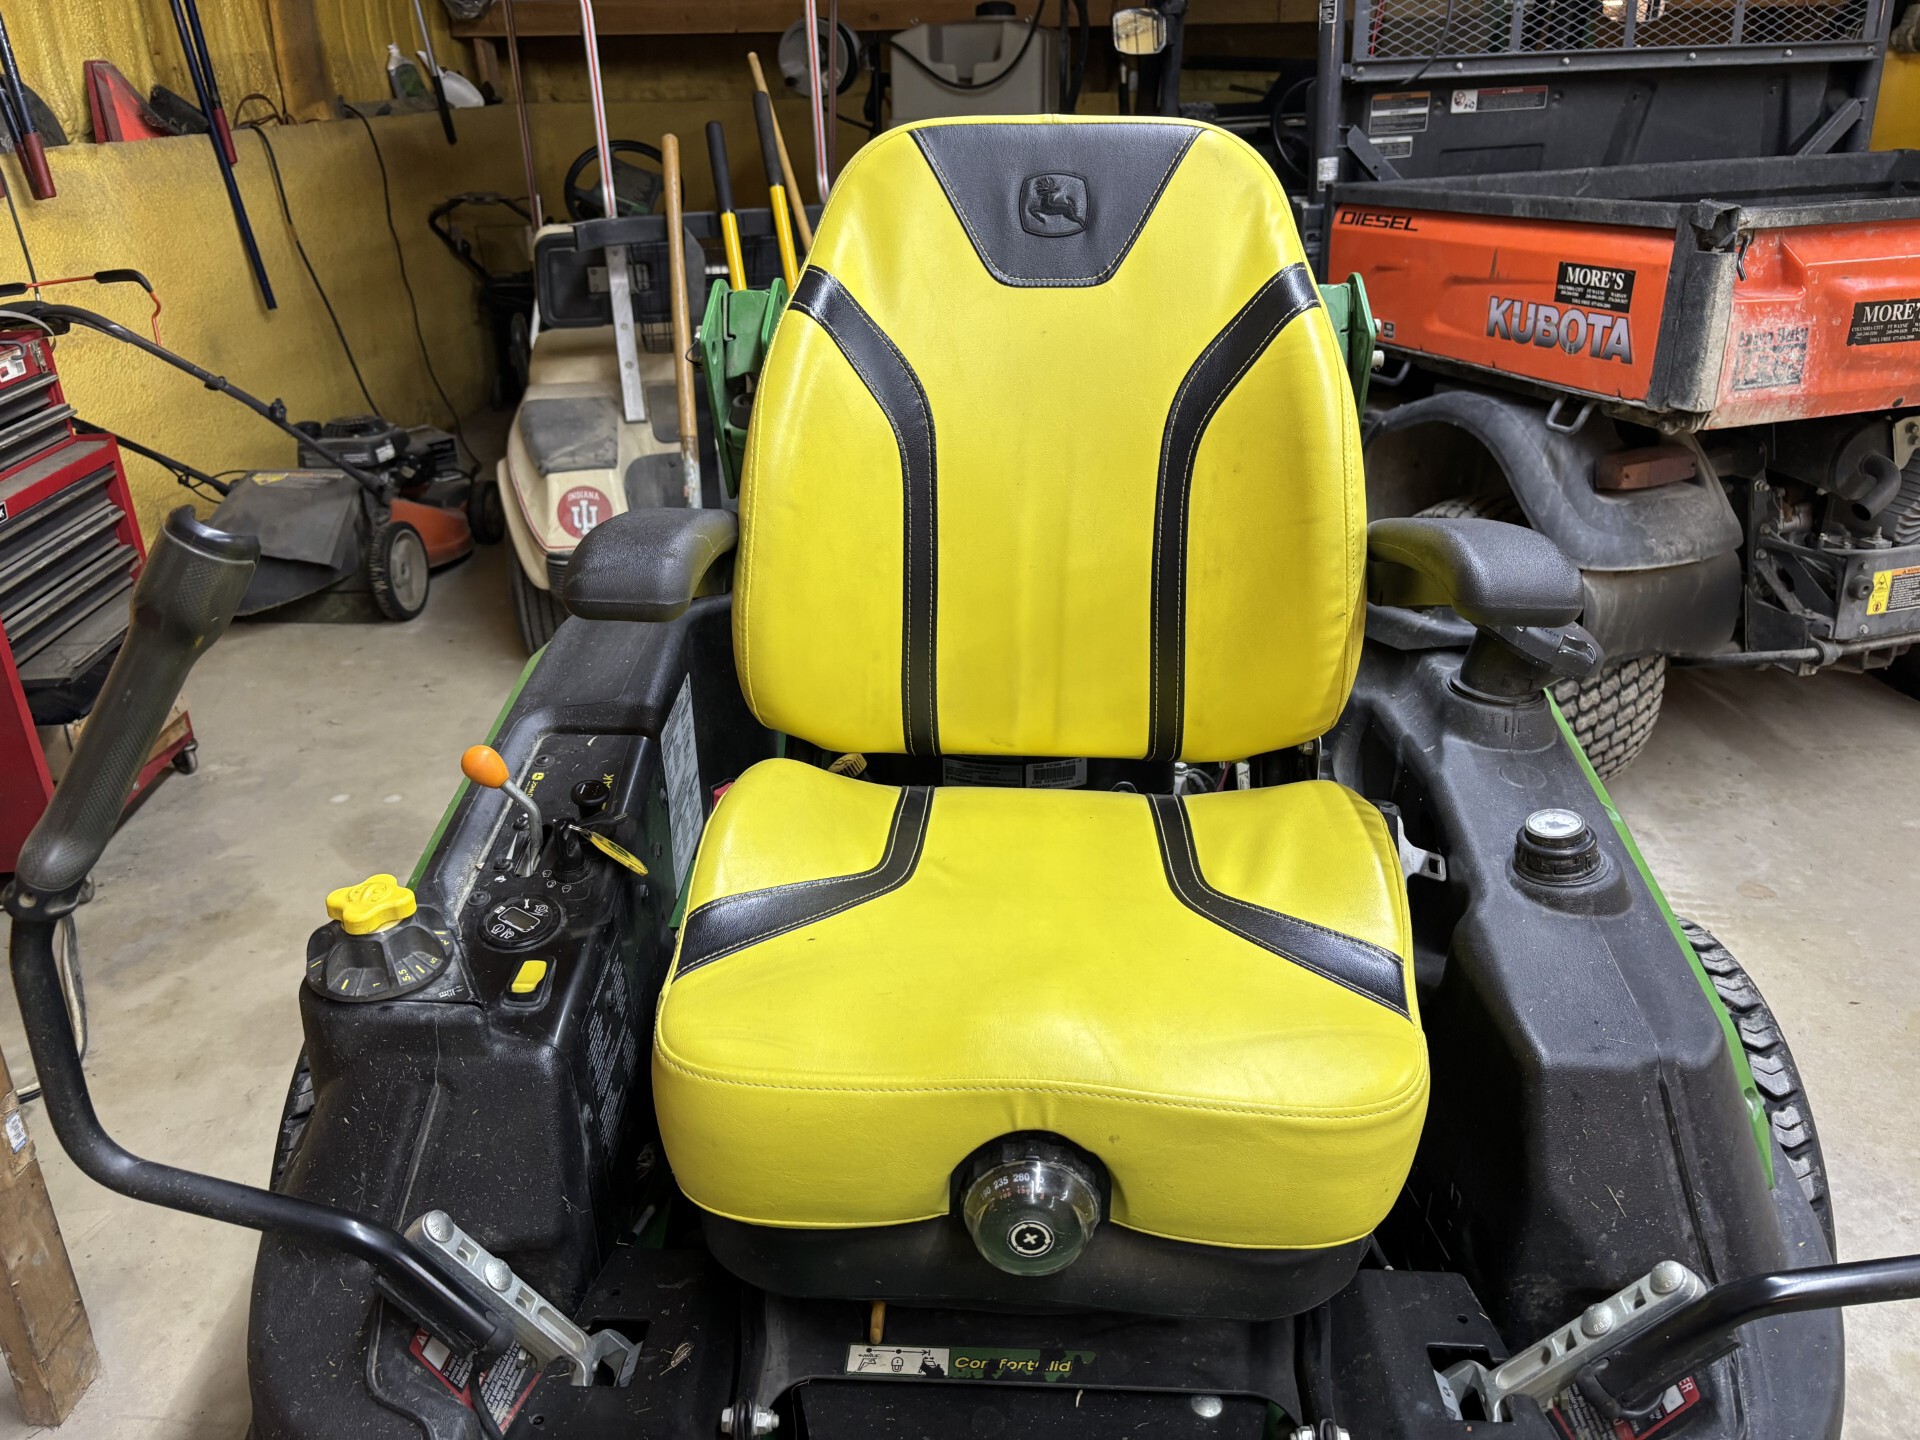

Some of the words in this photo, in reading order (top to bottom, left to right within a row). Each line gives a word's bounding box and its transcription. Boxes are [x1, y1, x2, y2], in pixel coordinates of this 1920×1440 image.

[1339, 211, 1418, 231] DIESEL
[1566, 266, 1625, 290] MORE'S
[1862, 303, 1920, 323] MORE'
[1486, 296, 1632, 364] KUBOTA
[568, 491, 600, 502] INDIANA
[993, 1176, 1008, 1190] 235
[1012, 1172, 1030, 1182] 280
